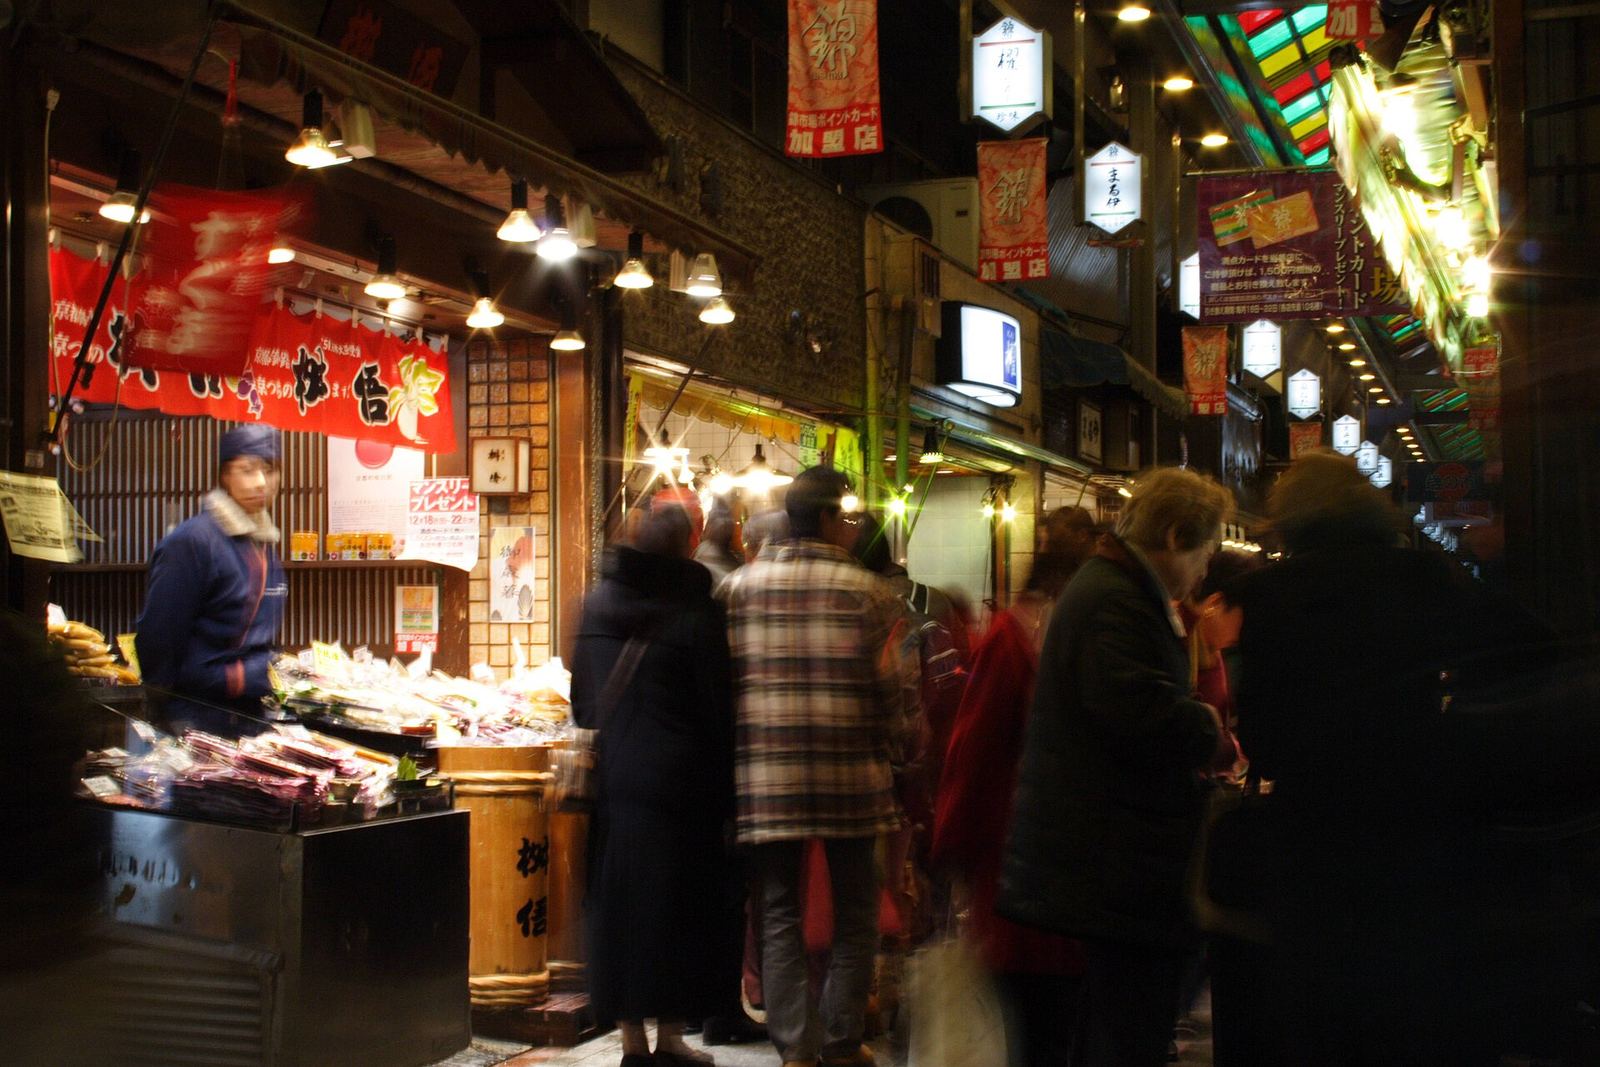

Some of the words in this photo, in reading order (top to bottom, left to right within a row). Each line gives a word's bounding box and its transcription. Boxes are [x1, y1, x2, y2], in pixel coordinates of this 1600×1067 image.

[789, 125, 878, 155] 加盟店
[1107, 167, 1121, 208] まる伊
[981, 258, 1047, 280] 加盟店
[411, 480, 469, 495] マンスリー
[411, 496, 474, 512] プレゼント
